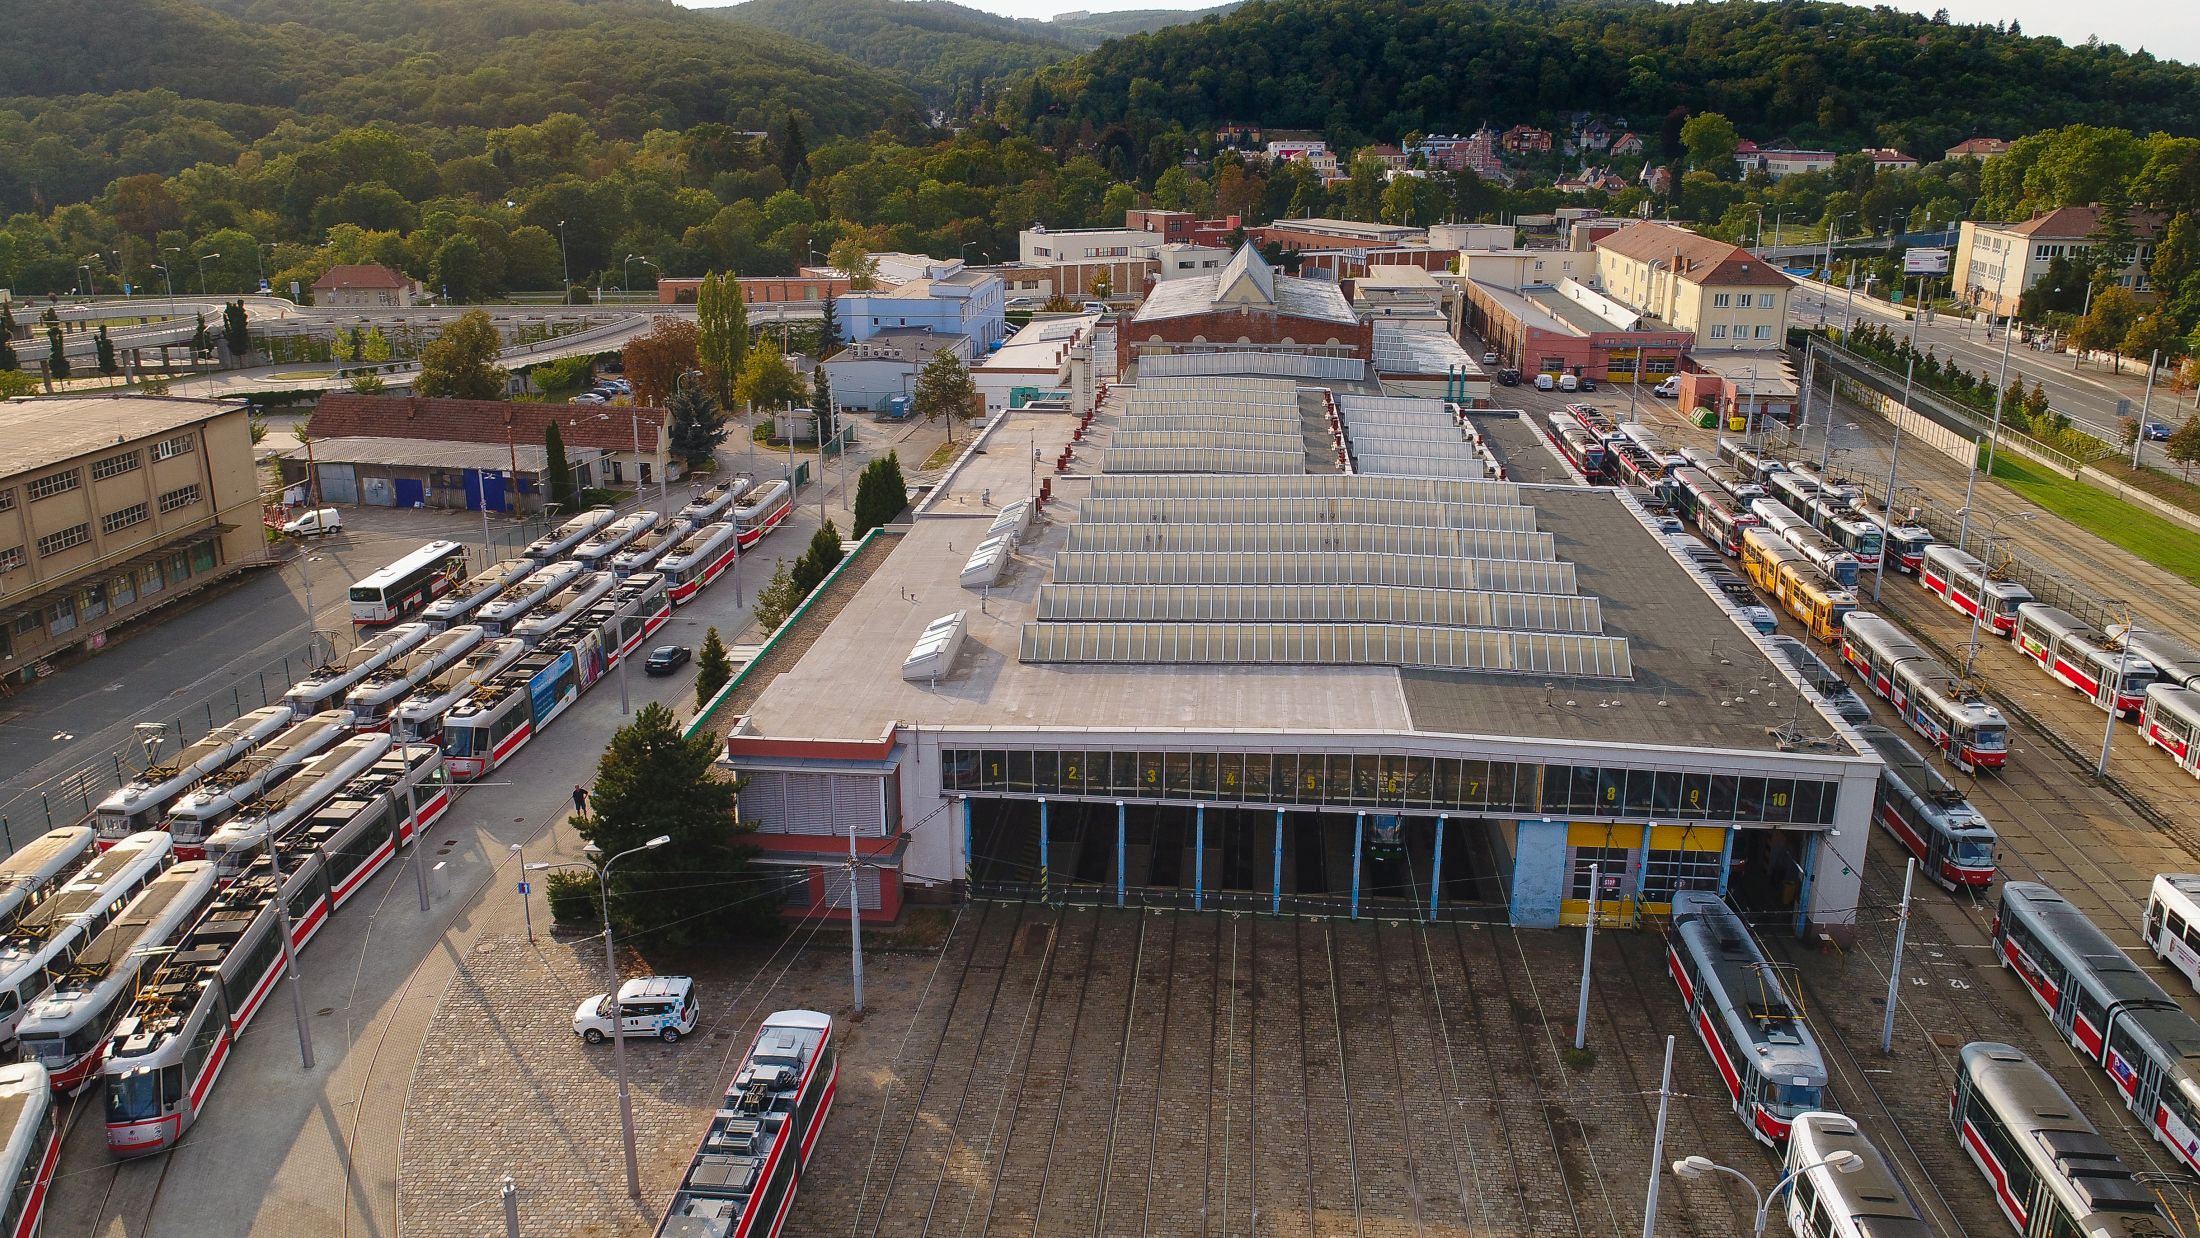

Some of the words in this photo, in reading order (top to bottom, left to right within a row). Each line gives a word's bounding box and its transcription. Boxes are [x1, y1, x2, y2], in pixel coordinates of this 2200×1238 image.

[992, 763, 998, 776] 1
[1069, 766, 1077, 779] 2
[1148, 769, 1156, 783] 3
[1227, 771, 1235, 786] 4
[1306, 775, 1315, 790] 5
[1388, 778, 1396, 793] 6
[1470, 781, 1479, 796] 7
[1607, 787, 1616, 801] 8
[1690, 789, 1699, 803] 9
[1772, 792, 1787, 807] 10
[1948, 978, 1970, 989] 12
